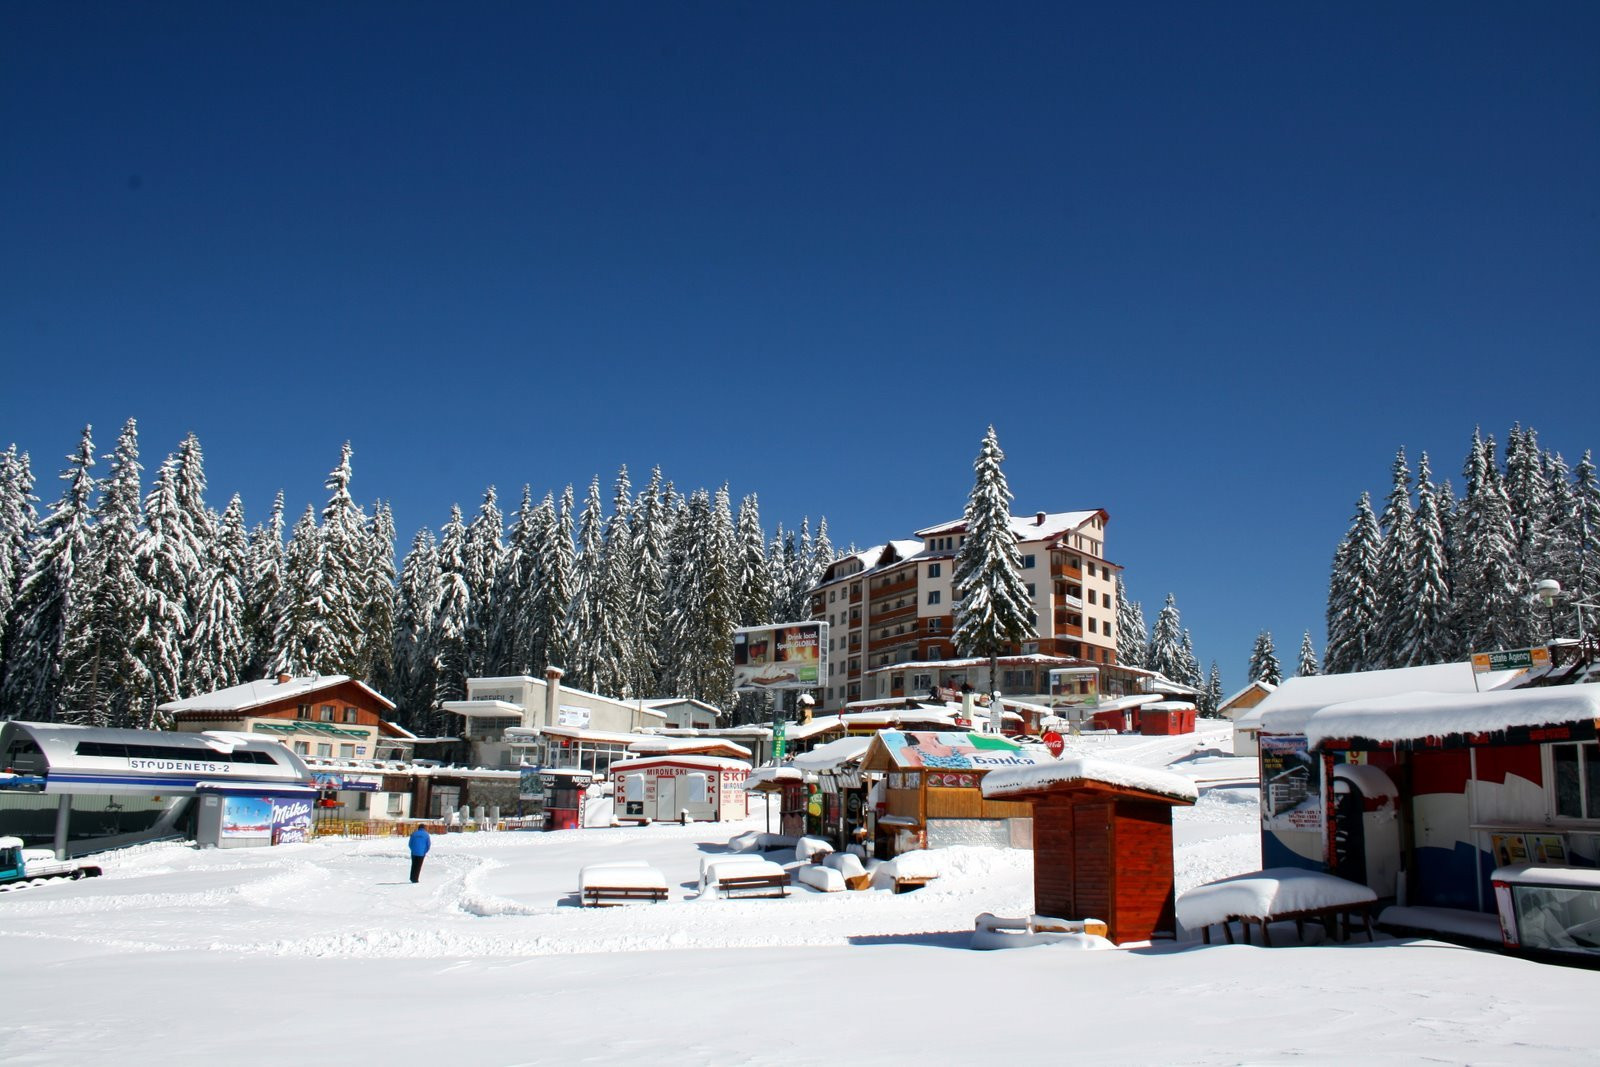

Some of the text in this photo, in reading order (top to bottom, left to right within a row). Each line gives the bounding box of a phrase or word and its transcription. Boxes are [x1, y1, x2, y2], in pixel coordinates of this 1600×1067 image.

[1489, 654, 1508, 663] Estate
[1508, 652, 1530, 664] Agency
[723, 772, 744, 781] SKI
[617, 775, 626, 804] СКИ
[708, 775, 716, 804] SKI
[272, 802, 310, 824] Milka
